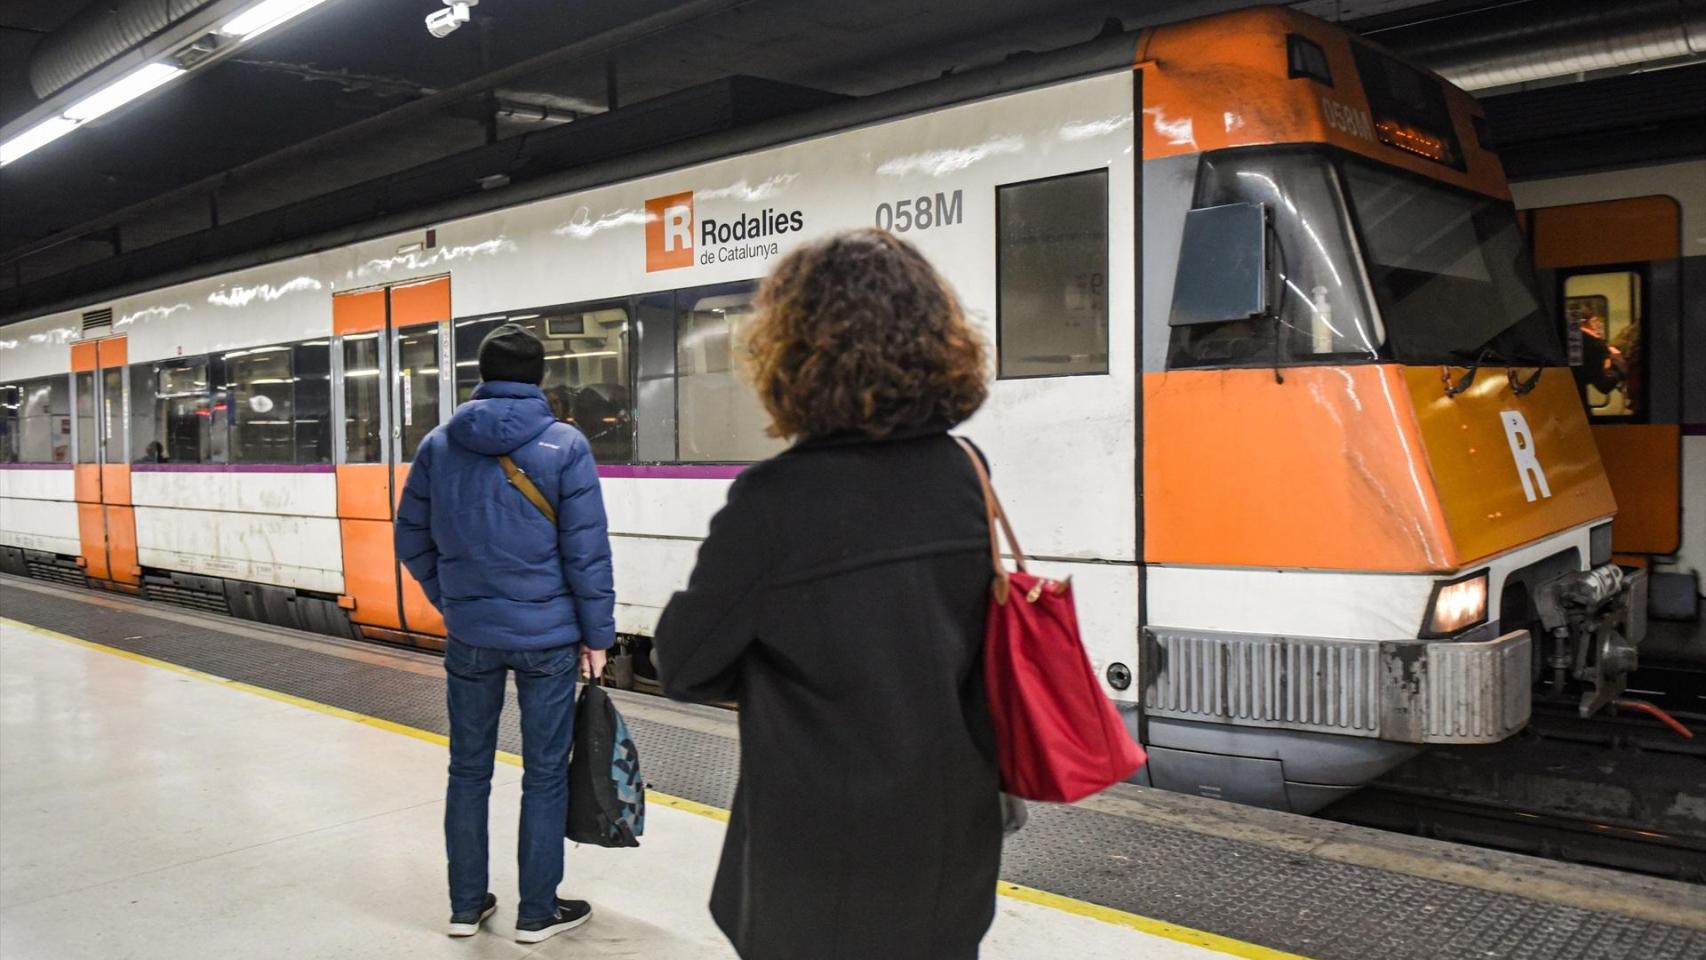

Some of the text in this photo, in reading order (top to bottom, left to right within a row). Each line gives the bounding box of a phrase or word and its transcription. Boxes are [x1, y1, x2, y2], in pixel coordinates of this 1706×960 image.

[664, 204, 692, 252] R
[701, 208, 804, 246] Rodalies
[875, 189, 963, 232] 058M
[700, 242, 778, 265] de Catalunya
[1500, 409, 1552, 503] R
